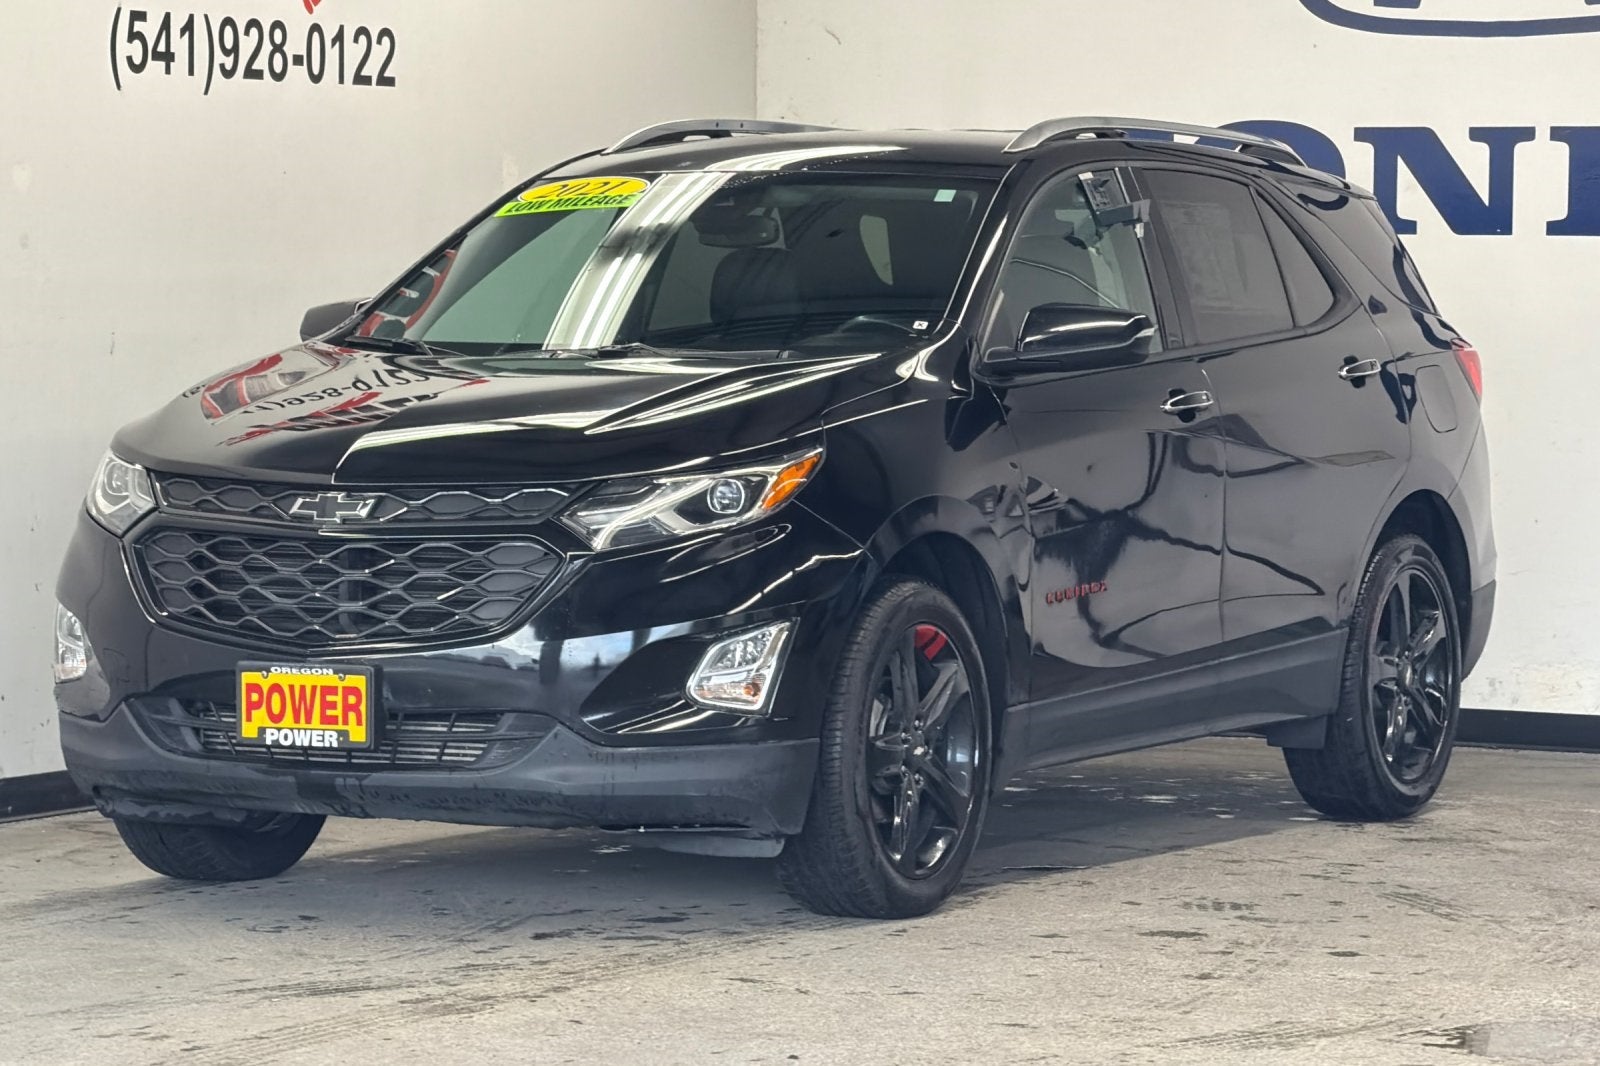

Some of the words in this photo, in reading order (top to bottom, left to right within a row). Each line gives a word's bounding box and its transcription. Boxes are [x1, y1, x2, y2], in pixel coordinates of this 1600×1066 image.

[110, 6, 396, 95] (541)928-0122
[533, 180, 629, 199] 2021
[505, 199, 544, 214] LOW
[547, 194, 635, 209] MILEAGE
[270, 666, 334, 676] OREGON
[245, 682, 364, 727] POWER
[265, 728, 339, 748] POWER
